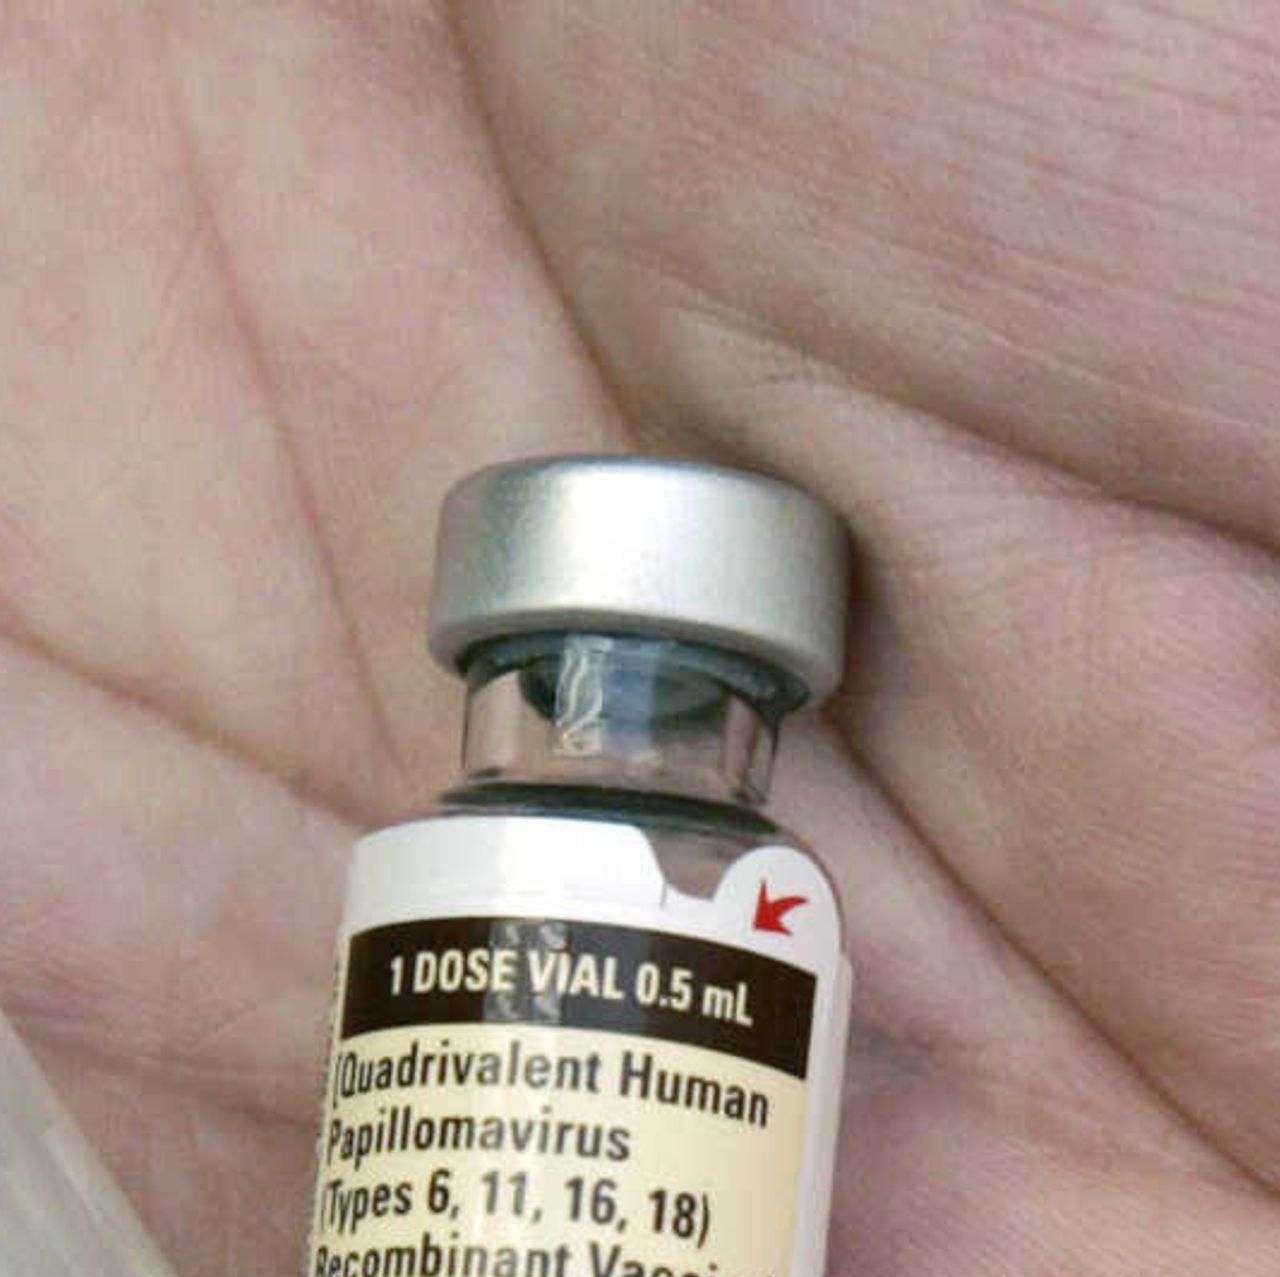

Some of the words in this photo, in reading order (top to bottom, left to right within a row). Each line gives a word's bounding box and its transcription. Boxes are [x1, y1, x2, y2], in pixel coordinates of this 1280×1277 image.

[390, 957, 402, 996] 1
[413, 950, 516, 993] DOSE
[527, 953, 625, 998] VIAL
[635, 961, 691, 1012] 0.5
[702, 981, 753, 1027] mL
[621, 1050, 770, 1128] Human
[326, 1105, 632, 1172] Papillomavirus
[320, 1178, 413, 1235] (Types
[428, 1168, 461, 1219] 6,
[479, 1171, 542, 1224] 11,
[564, 1176, 628, 1227] 16,
[648, 1188, 711, 1248] 18)
